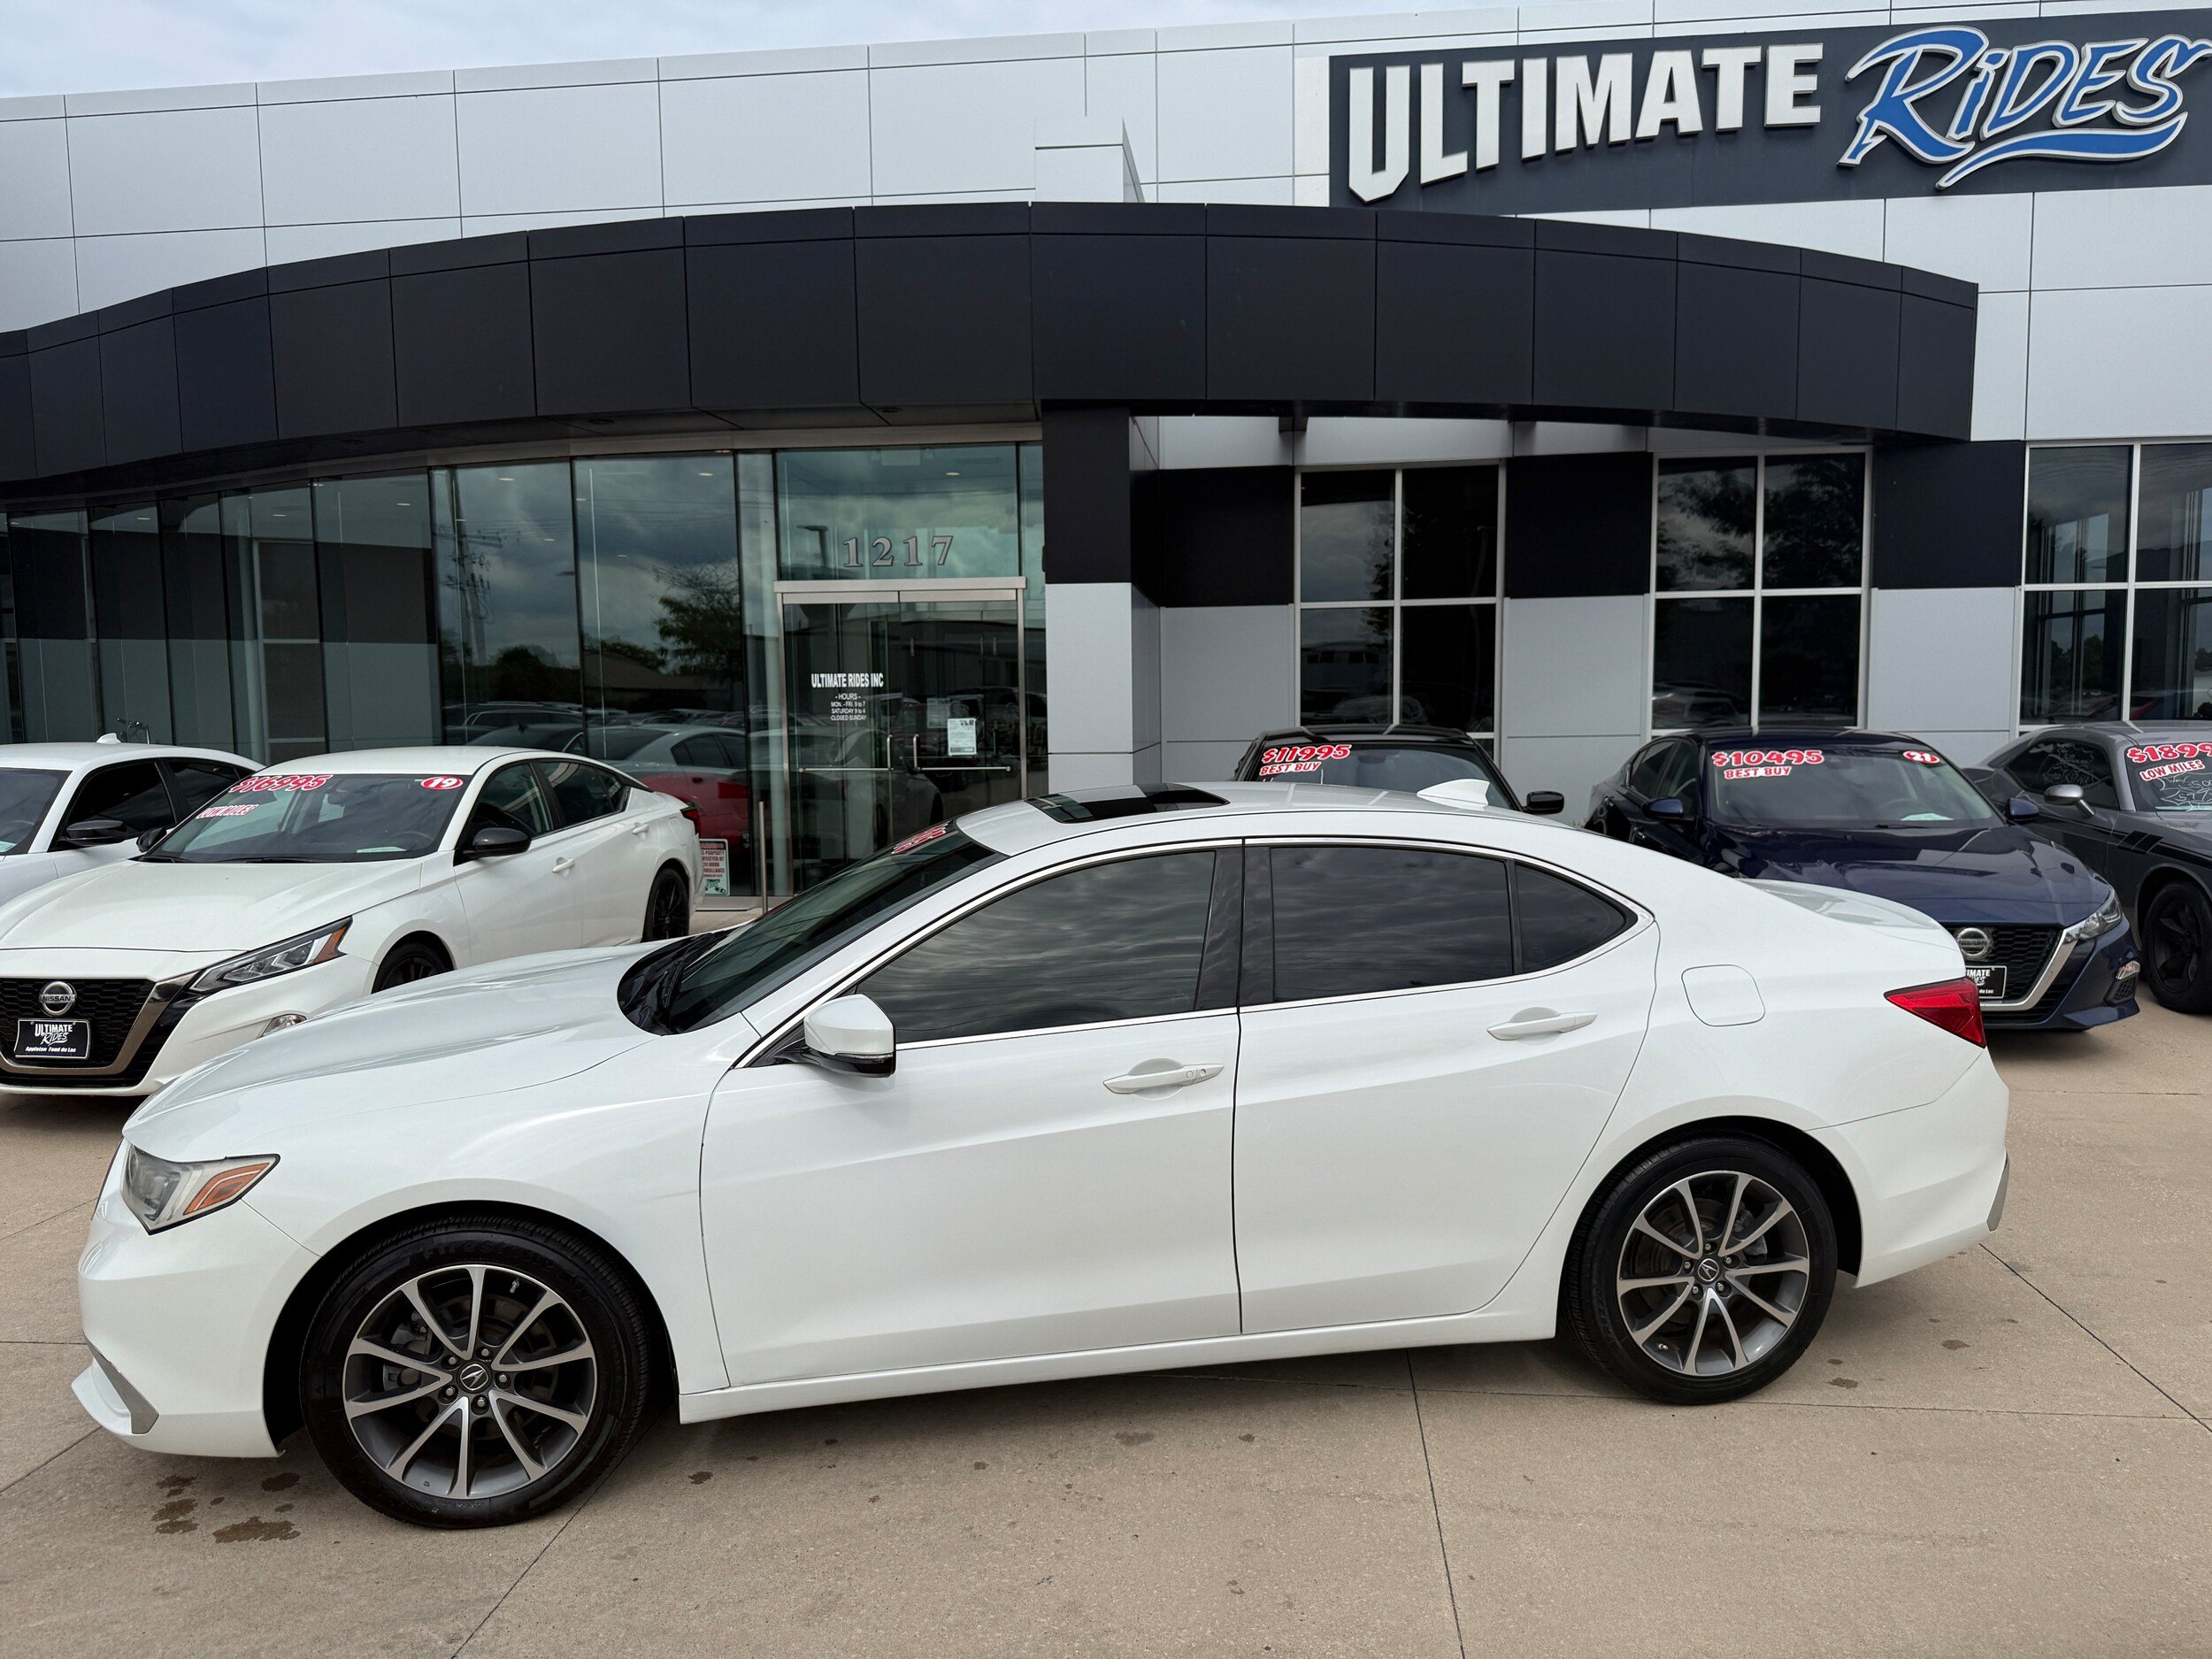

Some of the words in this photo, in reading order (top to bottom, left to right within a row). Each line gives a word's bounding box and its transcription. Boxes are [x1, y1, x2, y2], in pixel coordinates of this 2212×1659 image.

[1348, 42, 1824, 204] ULTIMATE
[843, 535, 954, 567] 1217
[810, 673, 847, 687] ULTIMATE
[848, 673, 870, 687] RIDES
[871, 672, 884, 687] INC
[1262, 744, 1352, 764] $11995
[1711, 749, 1824, 767] $10495
[1259, 763, 1292, 776] BEST
[1293, 761, 1322, 772] BUY
[1724, 767, 1760, 780] BEST
[1762, 765, 1792, 777] BUY
[2139, 767, 2168, 782] LOW
[2167, 759, 2205, 776] MILES
[228, 774, 334, 794] $16995
[428, 778, 458, 787] 19
[35, 1024, 73, 1036] ULTIMATE
